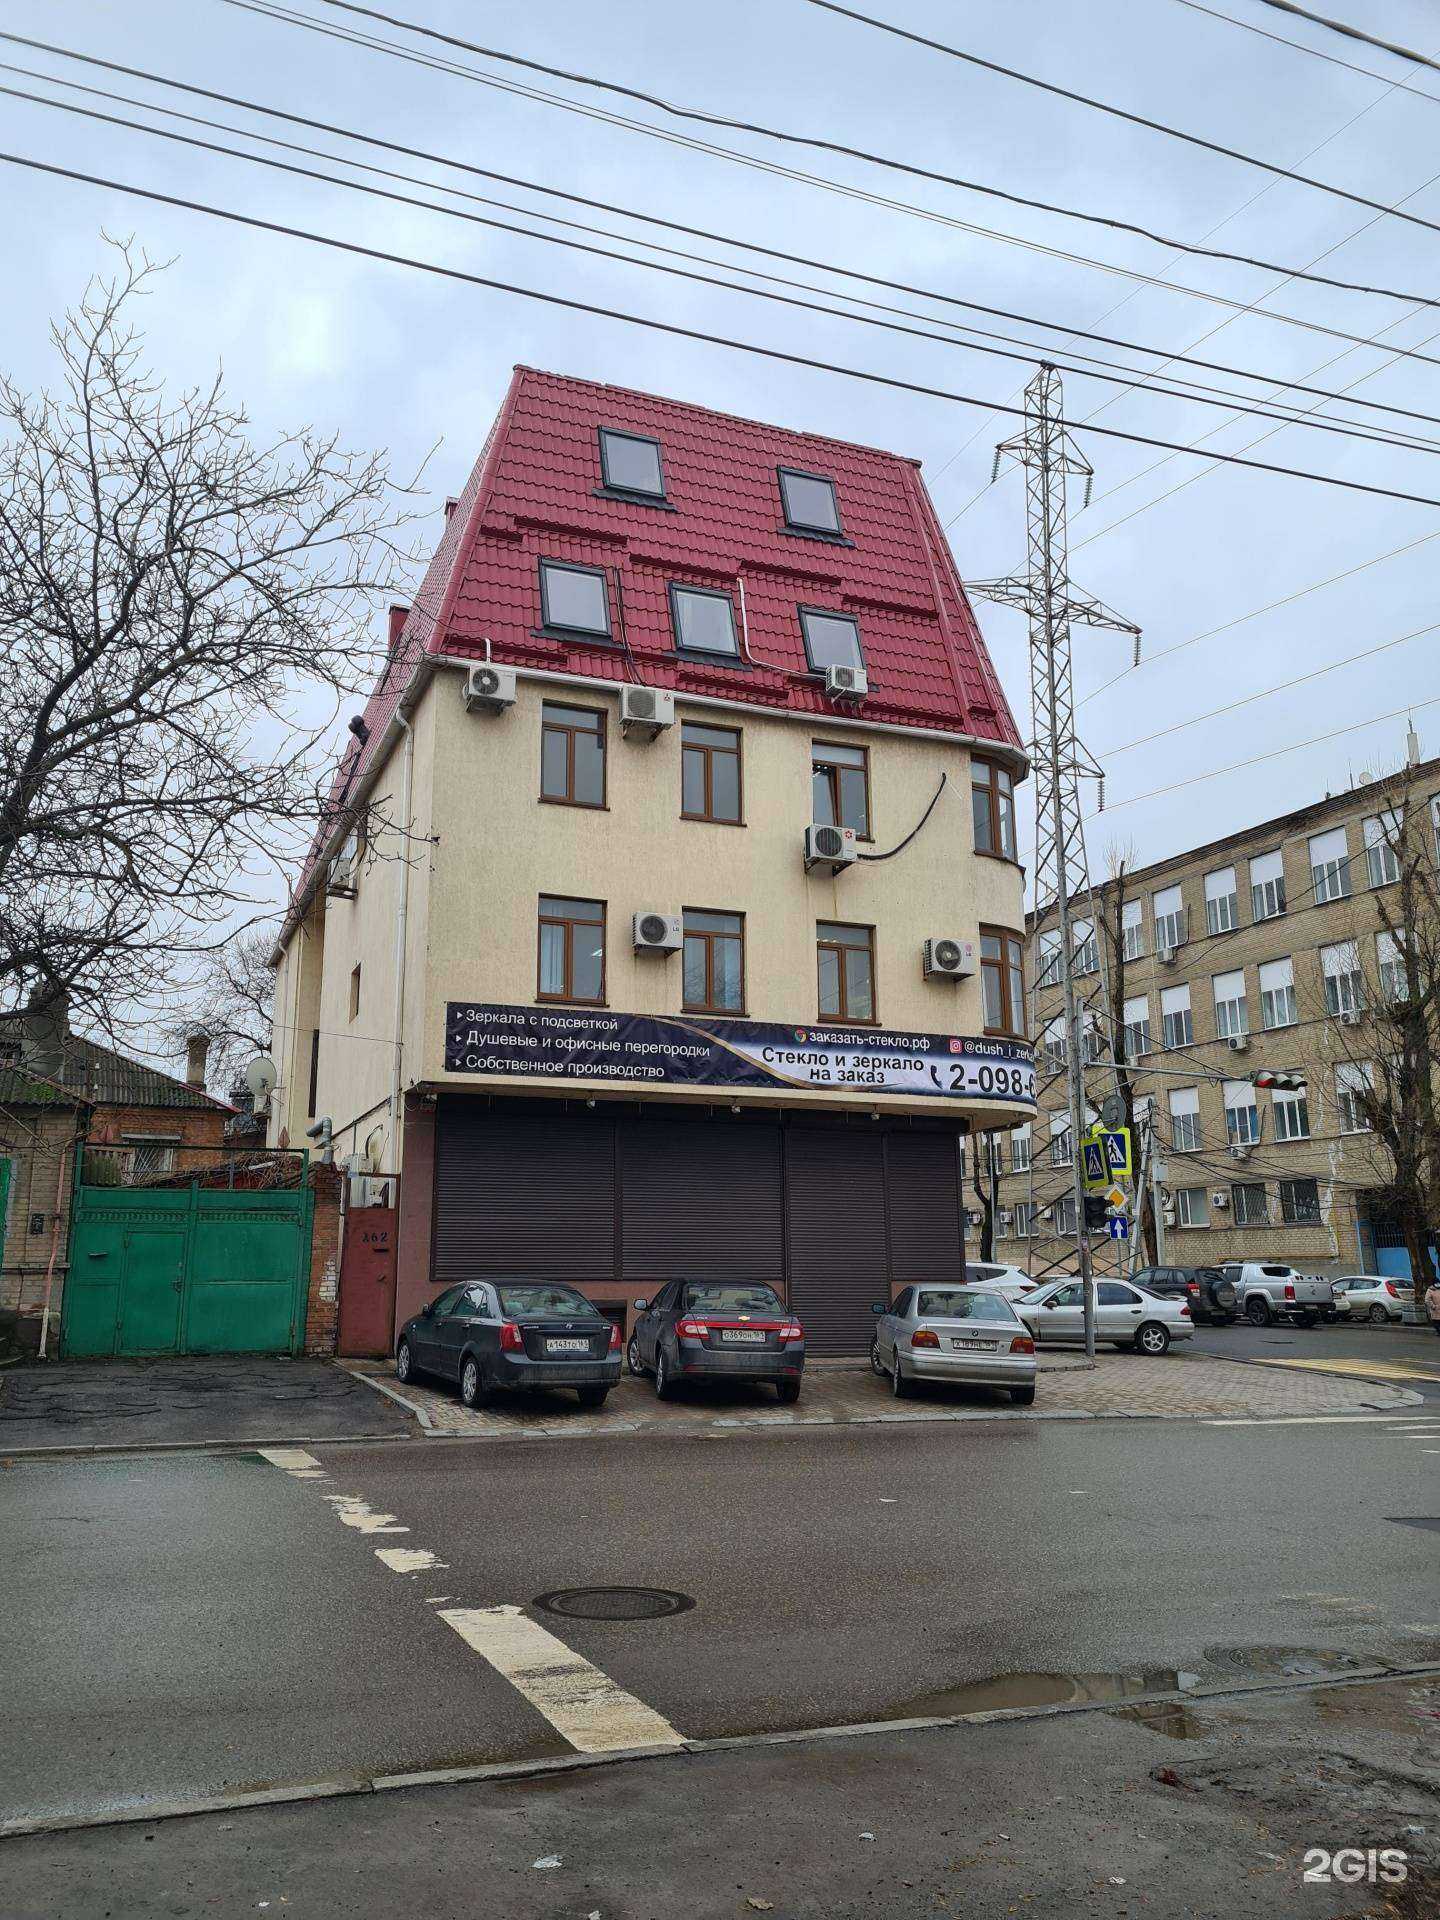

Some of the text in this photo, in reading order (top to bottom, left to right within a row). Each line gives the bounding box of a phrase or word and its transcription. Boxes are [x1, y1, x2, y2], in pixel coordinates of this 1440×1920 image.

[466, 1009, 618, 1030] Зеркала с подсветкой
[466, 1030, 710, 1057] Душевые и офисные перегородки
[809, 1031, 931, 1051] заказать-стекло.рф
[466, 1055, 665, 1077] Собственное производство
[762, 1046, 924, 1072] Стекло и зеркало
[810, 1068, 885, 1084] на заказ
